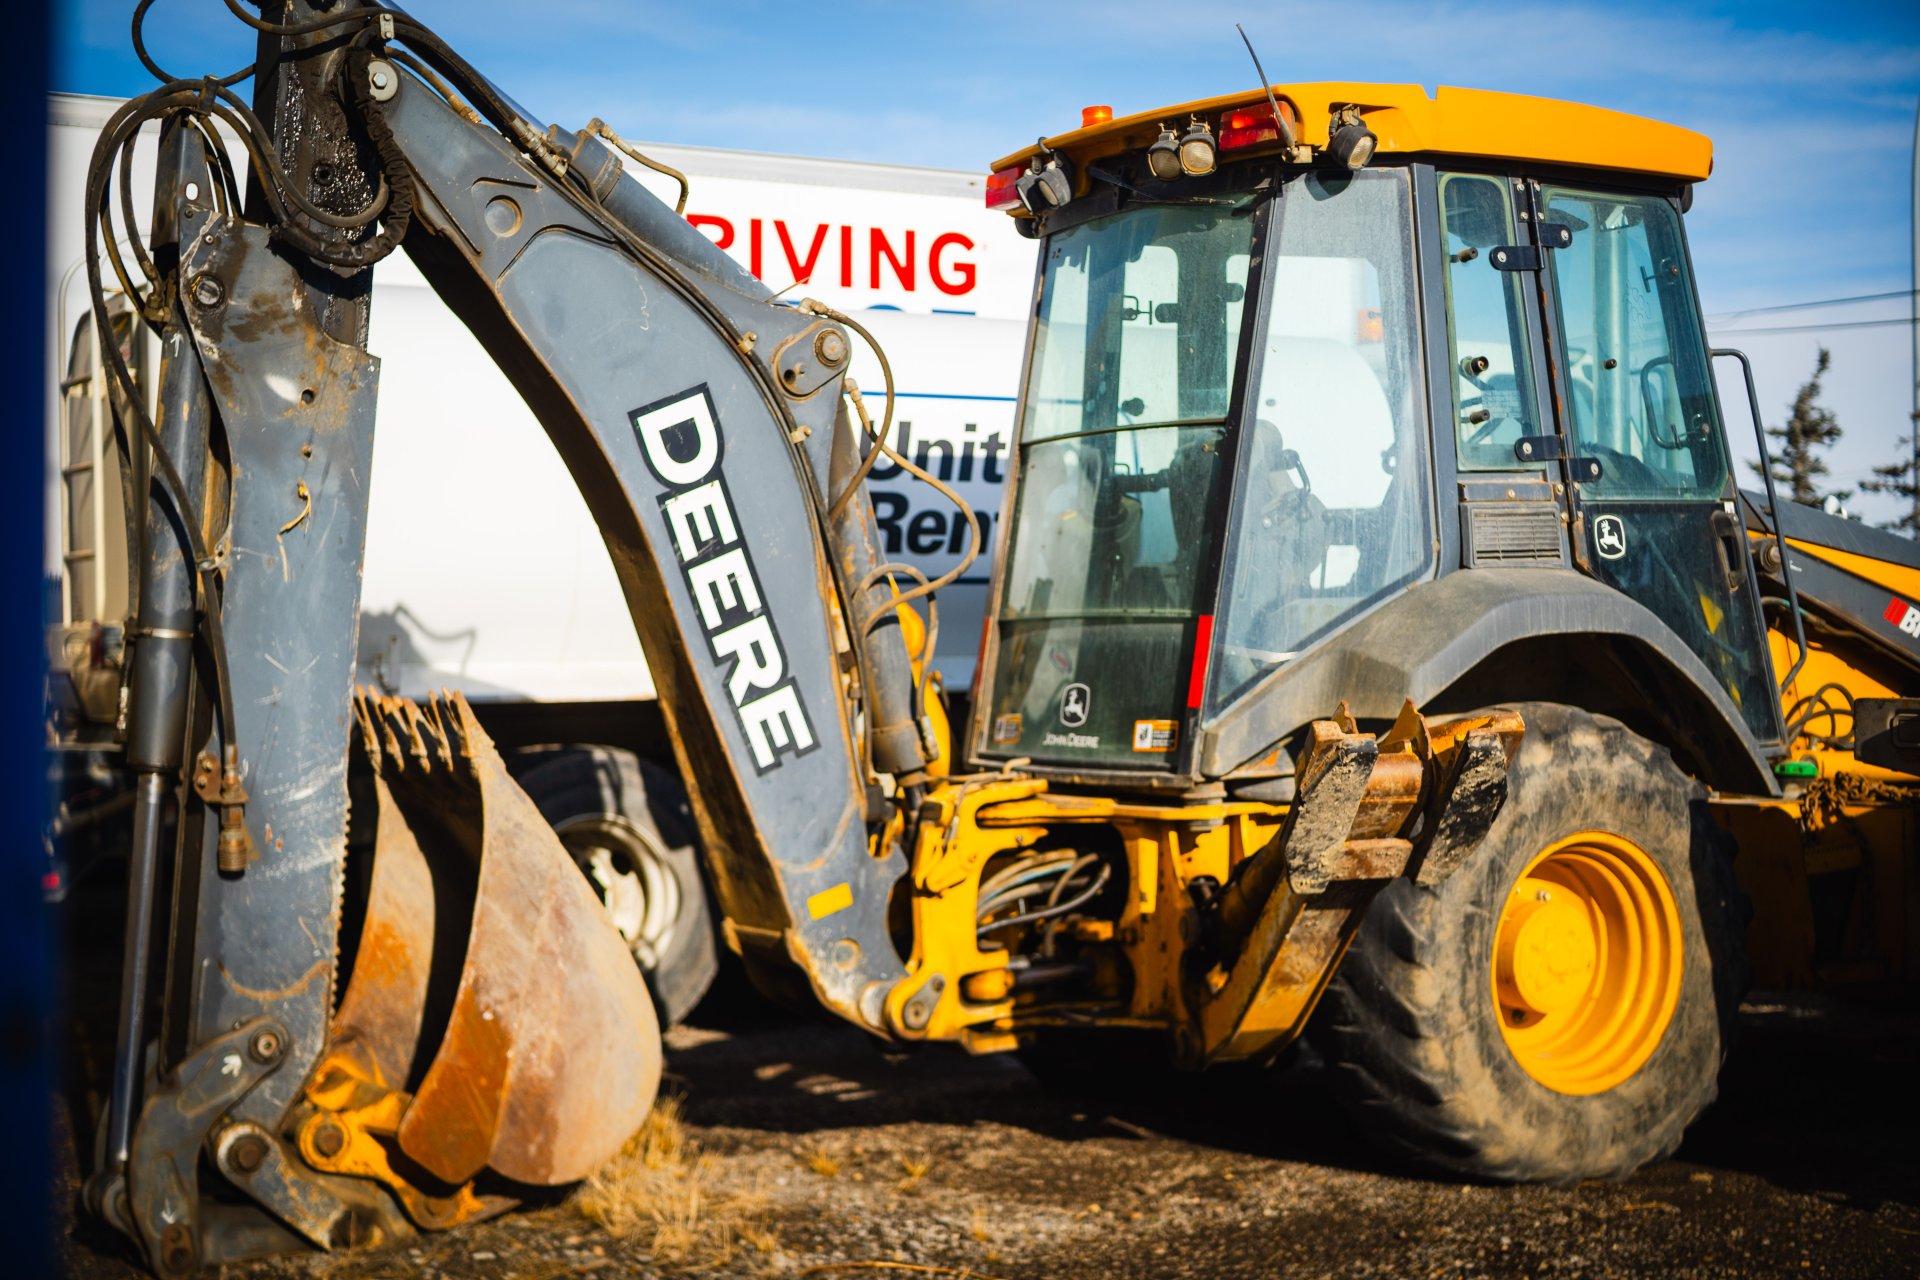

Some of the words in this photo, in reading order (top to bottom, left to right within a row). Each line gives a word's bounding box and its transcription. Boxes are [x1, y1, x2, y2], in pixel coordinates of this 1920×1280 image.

[869, 490, 1000, 555] Ren
[634, 390, 816, 771] DEERE
[1067, 732, 1100, 749] DEERE
